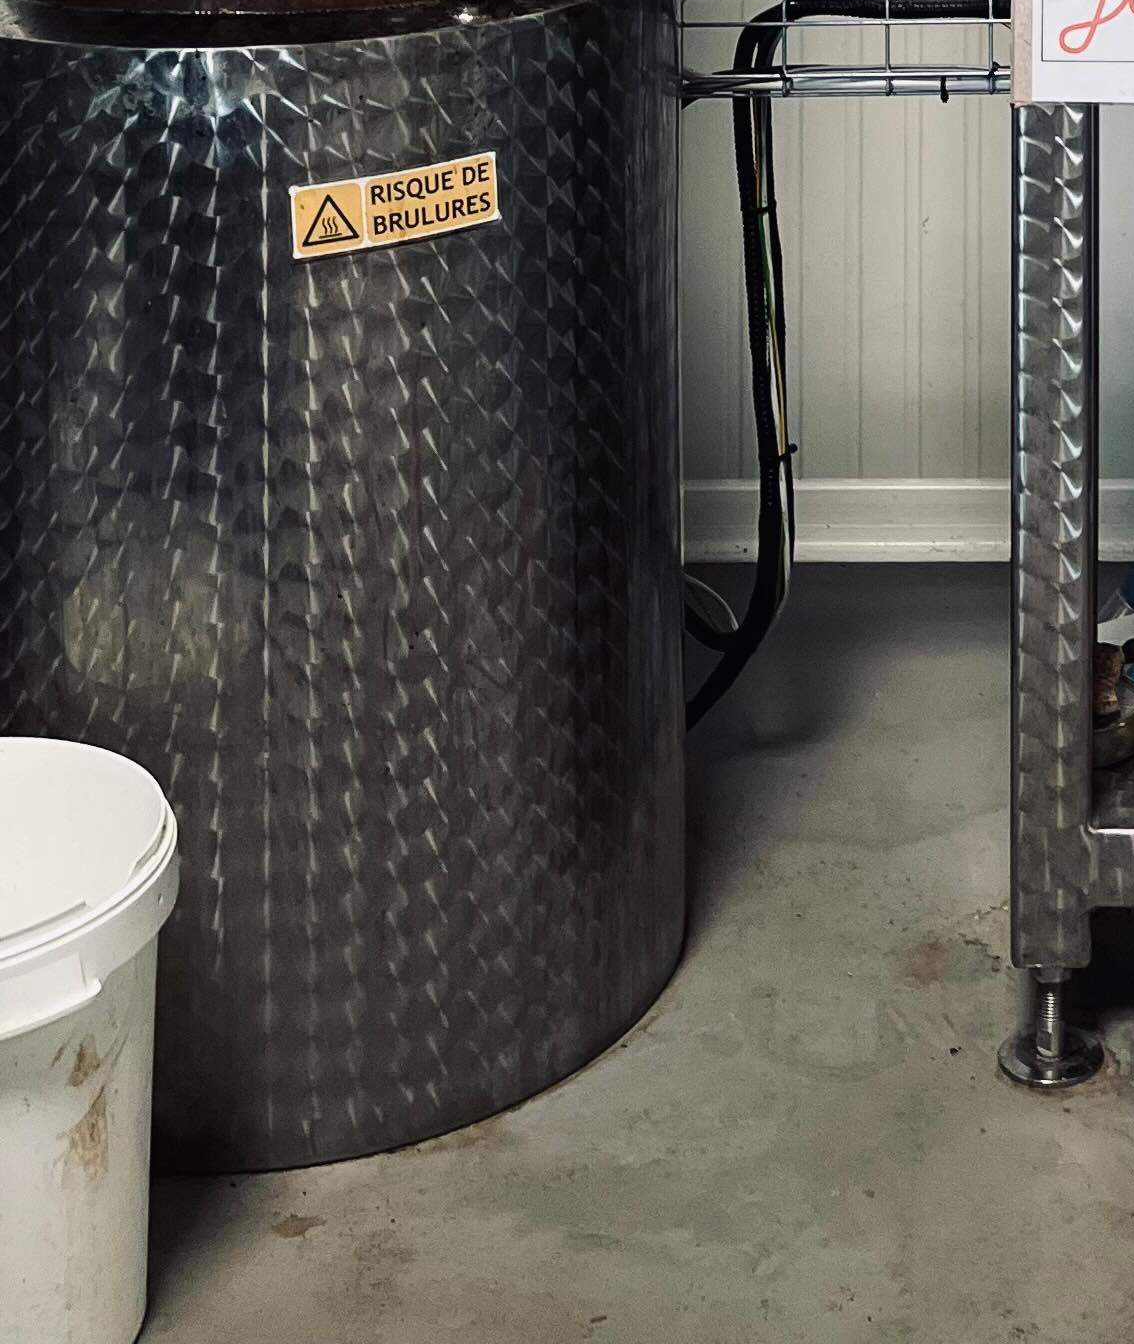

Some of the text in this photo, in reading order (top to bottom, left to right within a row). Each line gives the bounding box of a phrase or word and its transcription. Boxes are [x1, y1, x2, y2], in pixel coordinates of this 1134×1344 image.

[370, 162, 490, 205] RISQUE DE
[373, 192, 491, 236] BRULURES
